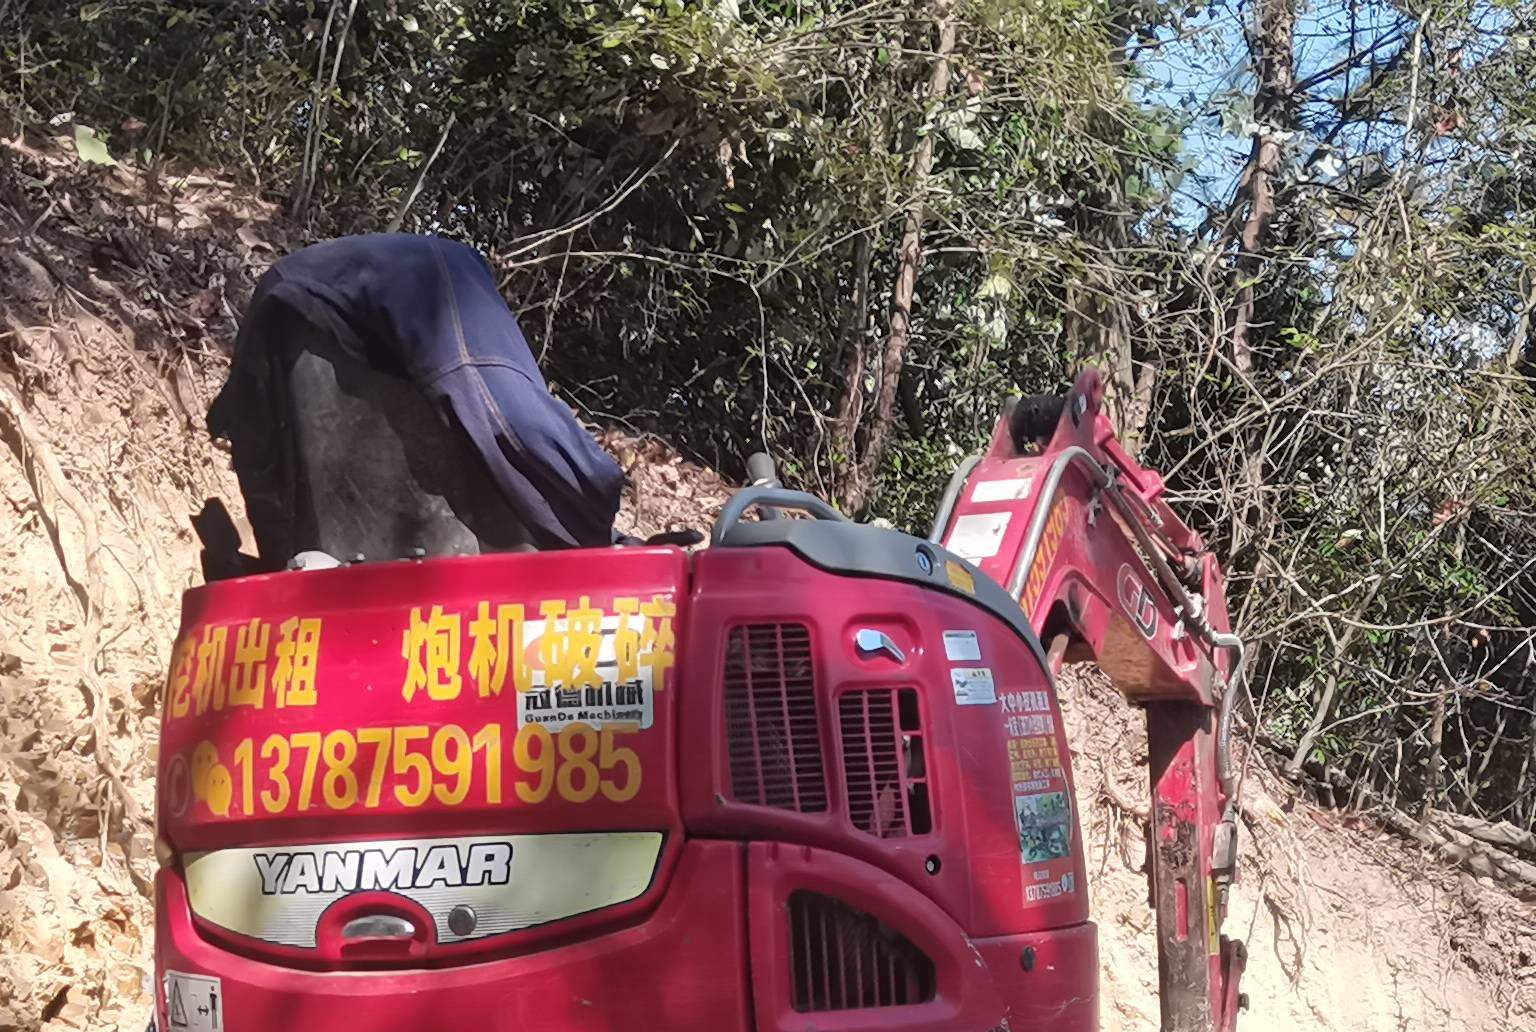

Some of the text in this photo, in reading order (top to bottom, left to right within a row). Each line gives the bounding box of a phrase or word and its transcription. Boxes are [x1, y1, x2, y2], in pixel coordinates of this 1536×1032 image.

[401, 594, 677, 703] 炮机破碎
[233, 722, 643, 816] 13787591985
[254, 841, 514, 895] YANMAR
